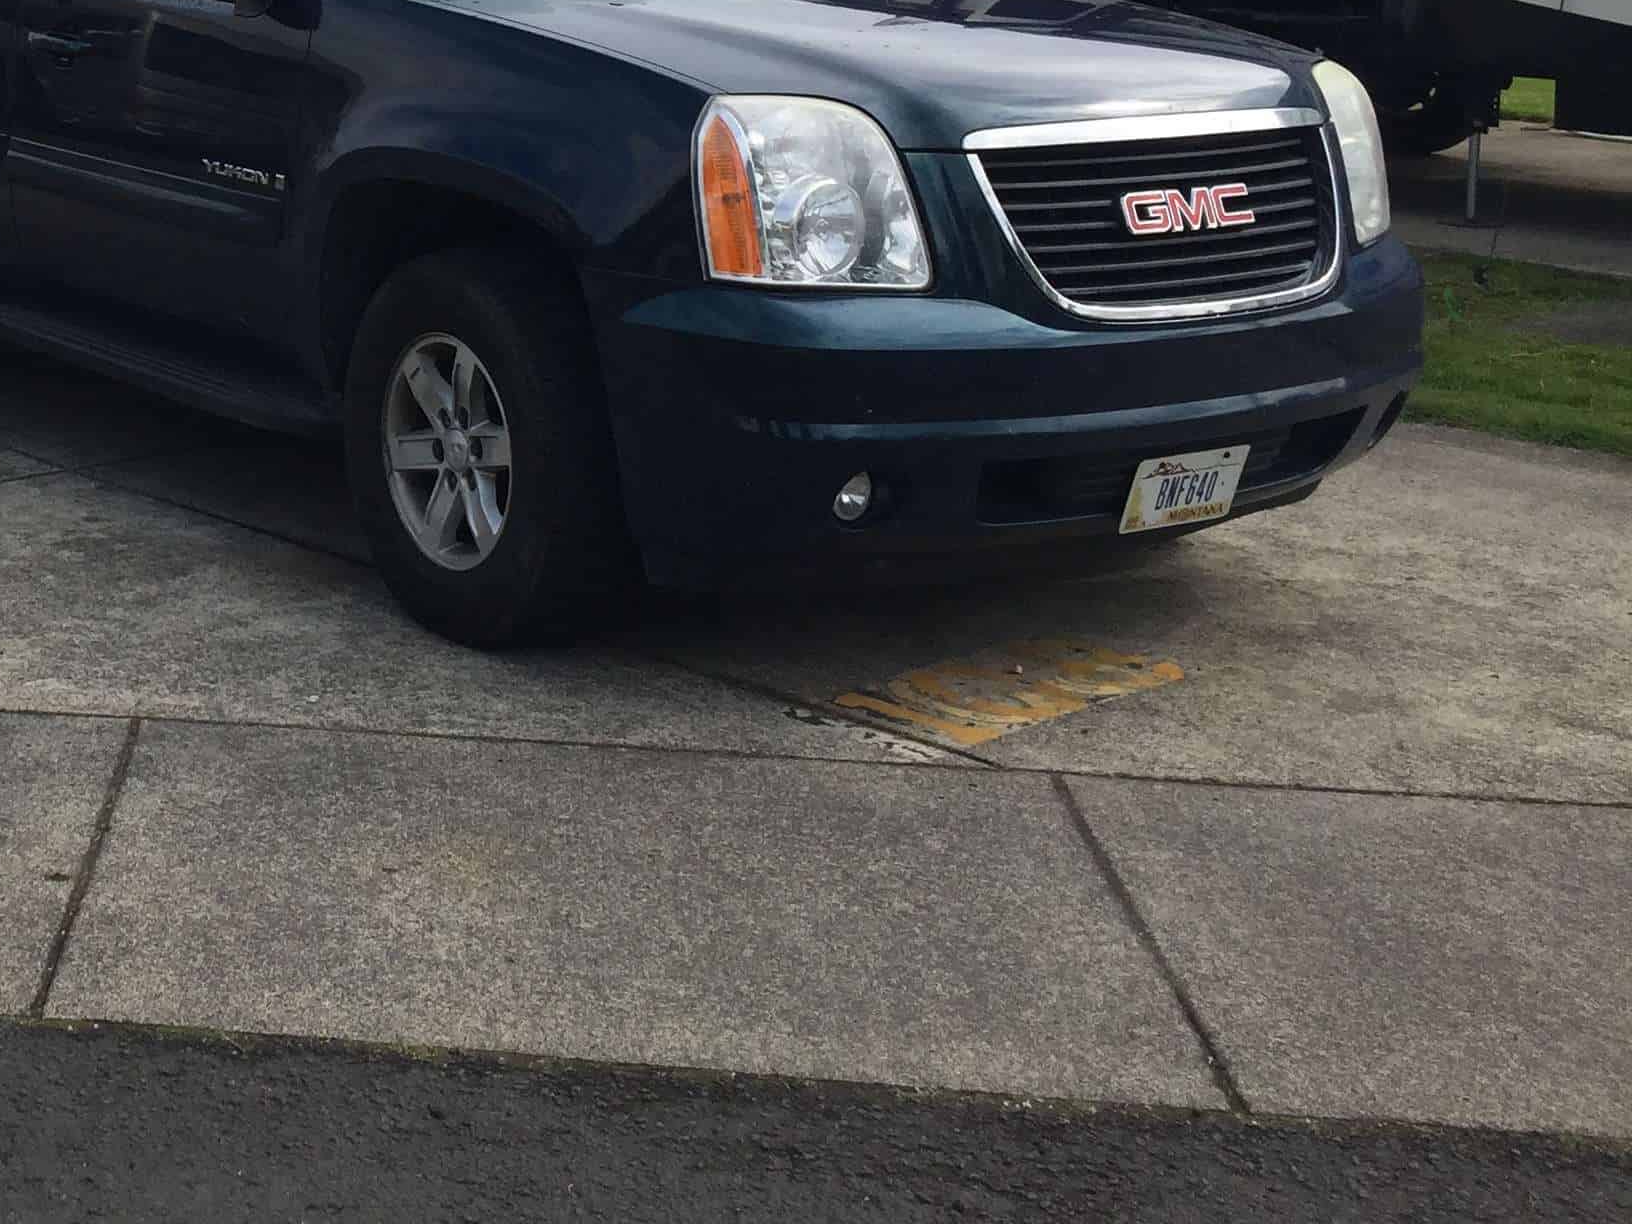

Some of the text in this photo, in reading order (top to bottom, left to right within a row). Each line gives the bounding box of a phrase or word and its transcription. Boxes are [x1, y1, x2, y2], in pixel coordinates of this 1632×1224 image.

[202, 158, 269, 185] YUKON
[1120, 182, 1256, 236] GMC
[1154, 470, 1220, 511] BNF640
